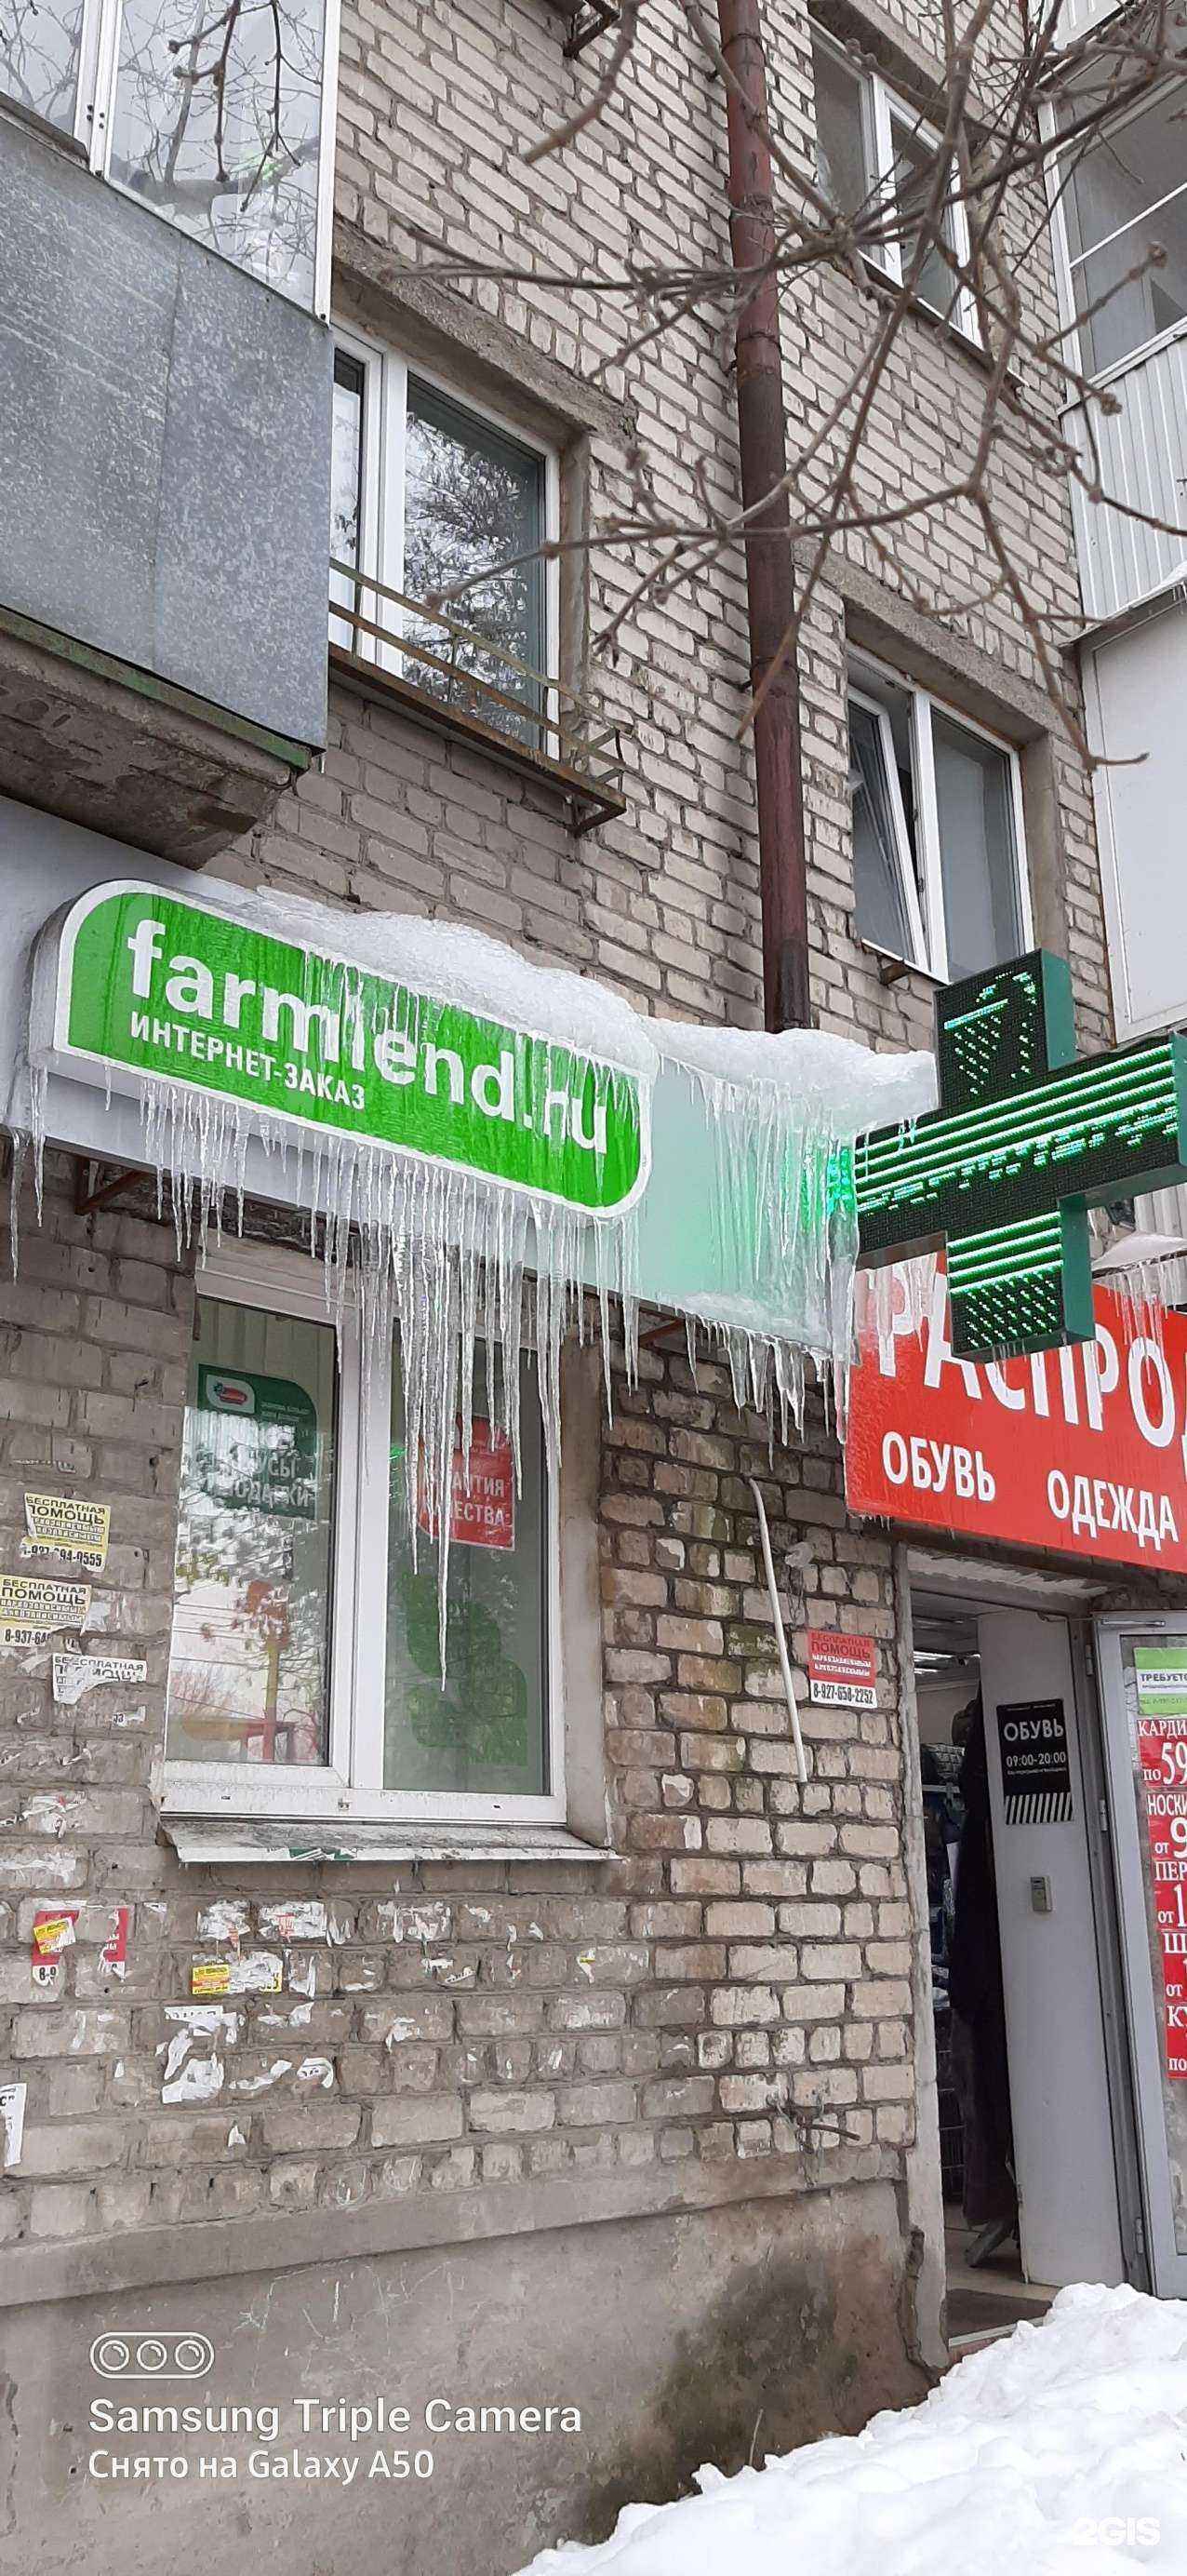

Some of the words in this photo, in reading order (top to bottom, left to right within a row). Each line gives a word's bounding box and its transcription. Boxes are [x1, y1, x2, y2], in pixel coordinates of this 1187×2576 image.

[128, 919, 607, 1155] farmlend.ru
[129, 1011, 366, 1111] ИНТЕРНЕТ-ЗАКАЗ
[881, 1430, 996, 1502] ОБУВЬ
[1047, 1469, 1180, 1551] ОДЕЖДА
[26, 1496, 105, 1515] БЕСПЛАТНАЯ
[3, 1578, 87, 1595] БЕСПЛАТНАЯ
[2, 1587, 86, 1606] ПОМОЩЬ
[811, 1641, 871, 1660] ПОМОЩЬ
[1004, 1718, 1064, 1741] ОБУВЬ
[1138, 1720, 1187, 1739] КАРДИ
[1142, 1768, 1161, 1781] по
[1154, 1843, 1169, 1855] от
[1157, 1911, 1174, 1924] от
[1166, 1983, 1183, 1997] от
